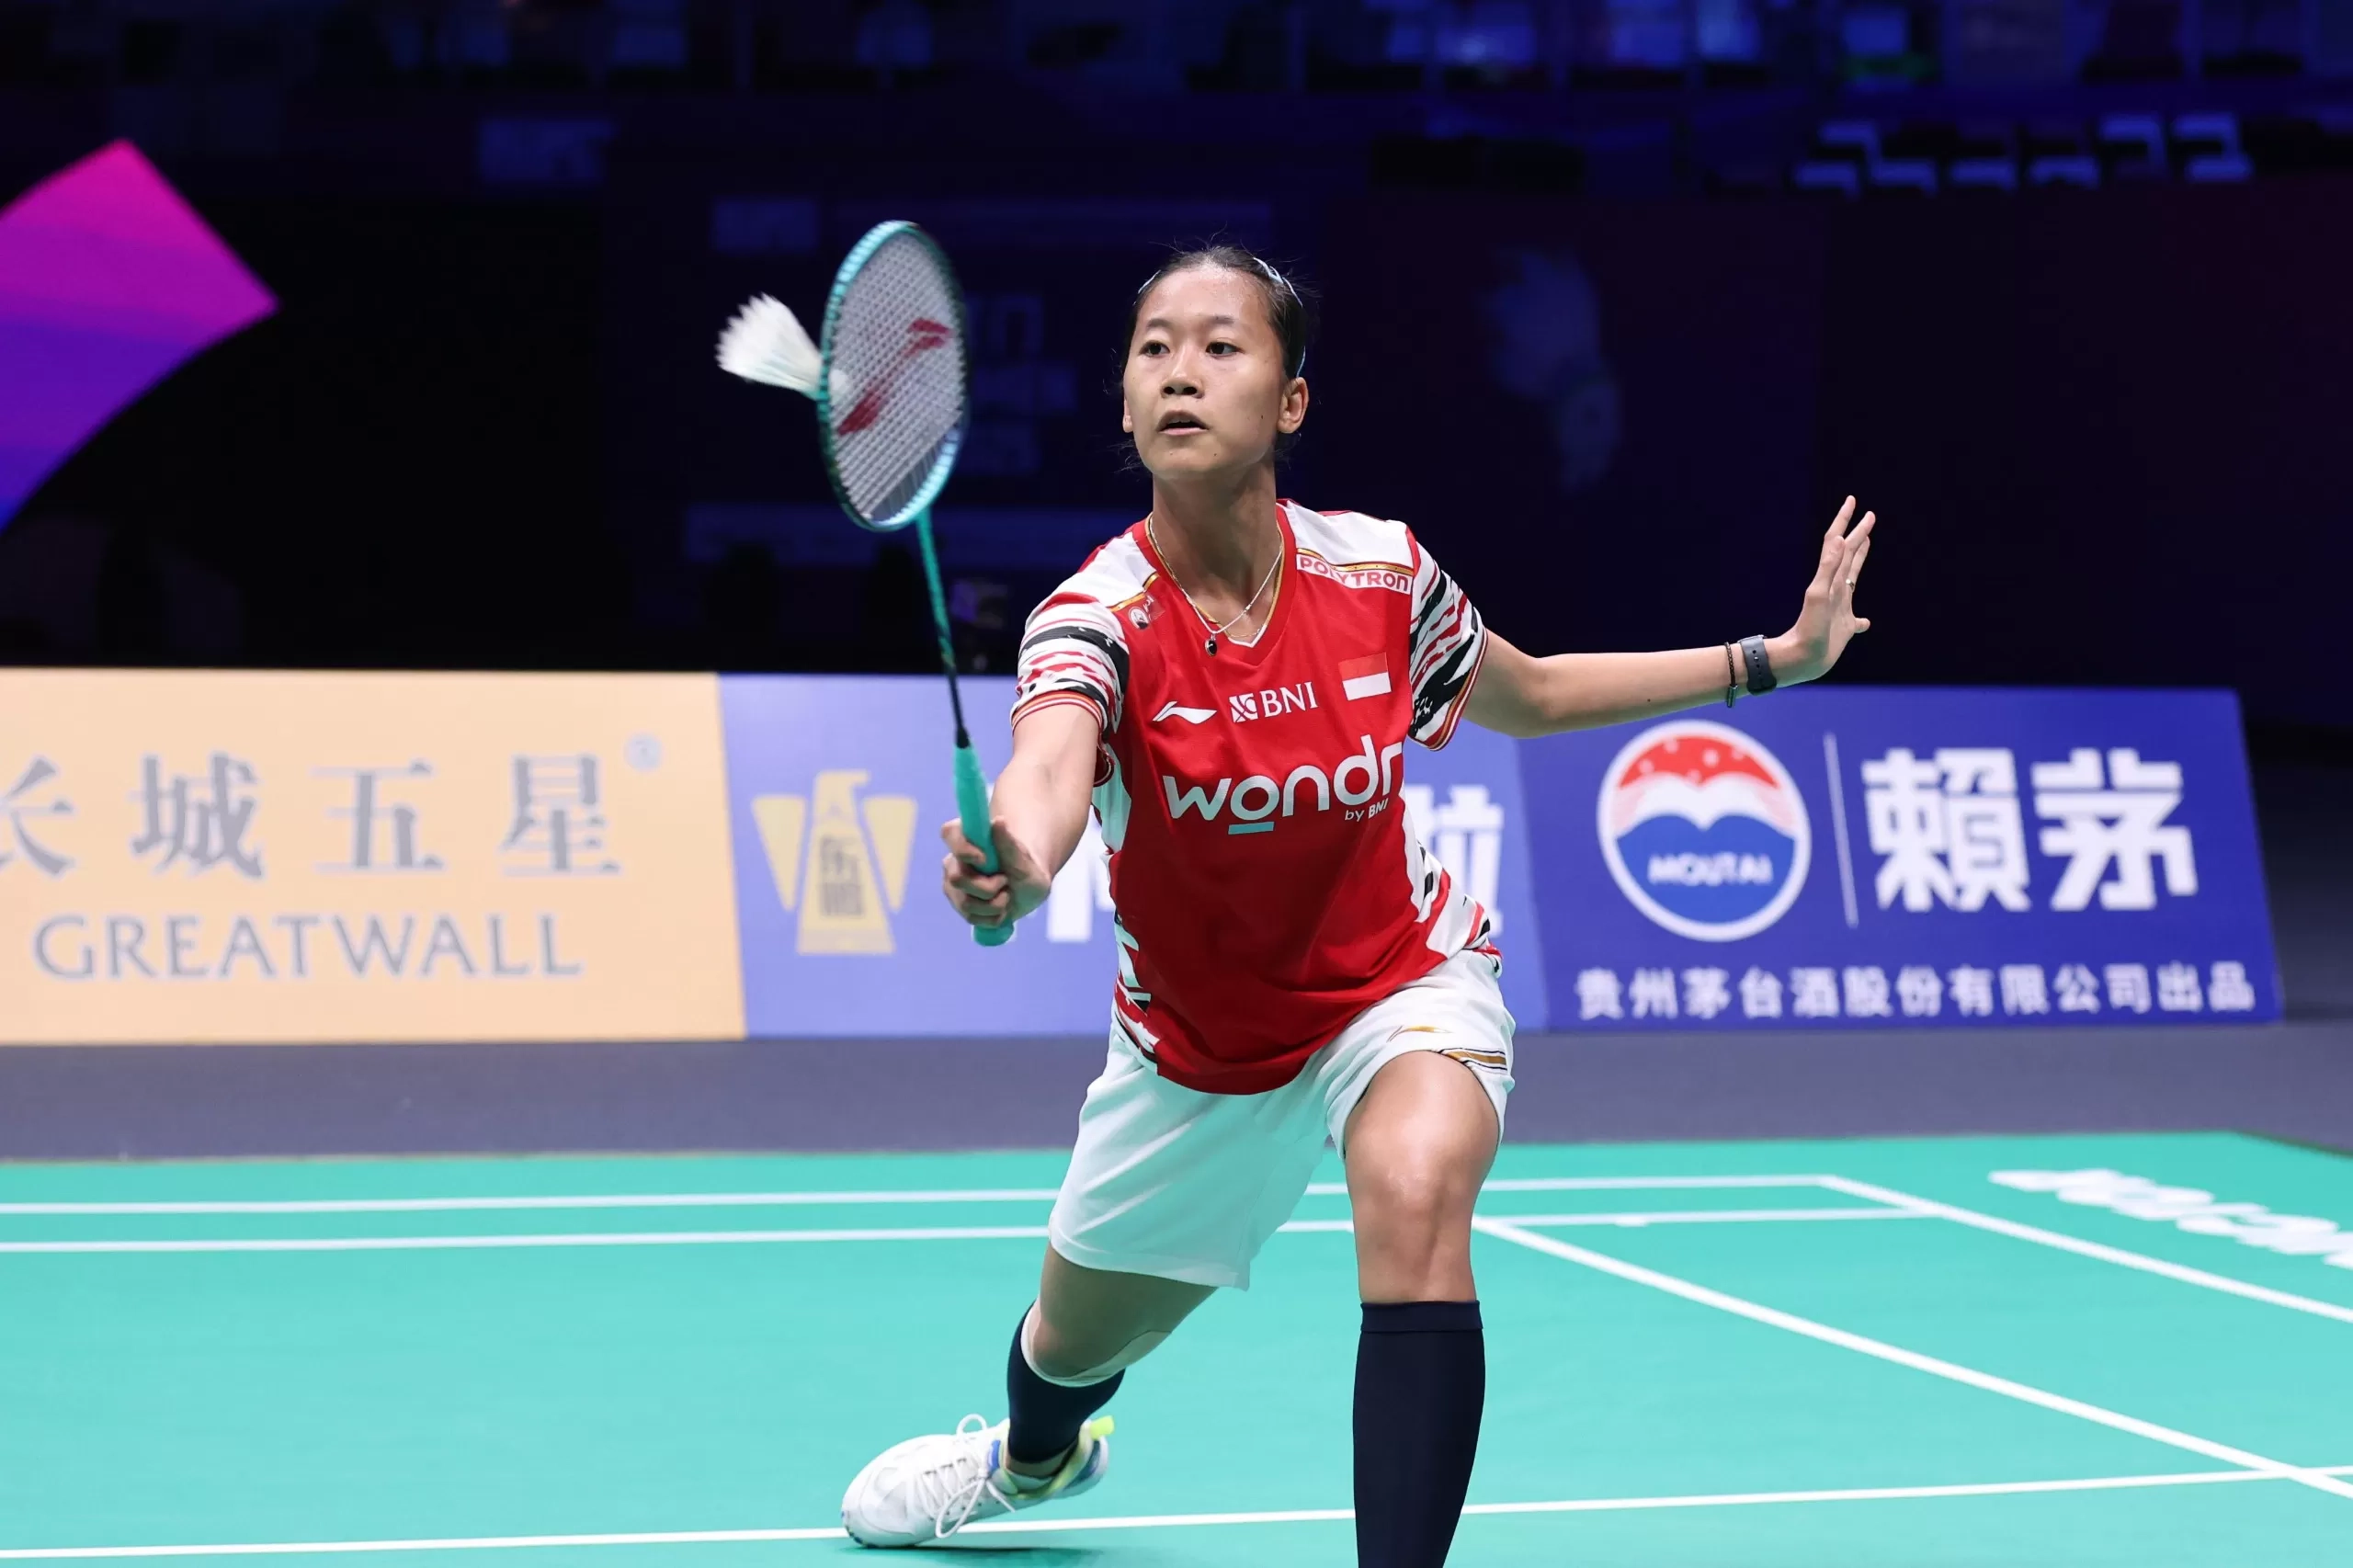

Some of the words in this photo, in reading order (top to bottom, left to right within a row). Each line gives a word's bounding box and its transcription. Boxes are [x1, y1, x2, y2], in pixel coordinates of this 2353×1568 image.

[1260, 681, 1318, 718] BNI
[1162, 733, 1403, 821] wondr
[1344, 809, 1365, 823] by
[1368, 797, 1389, 819] BNI
[33, 913, 583, 982] GREATWALL
